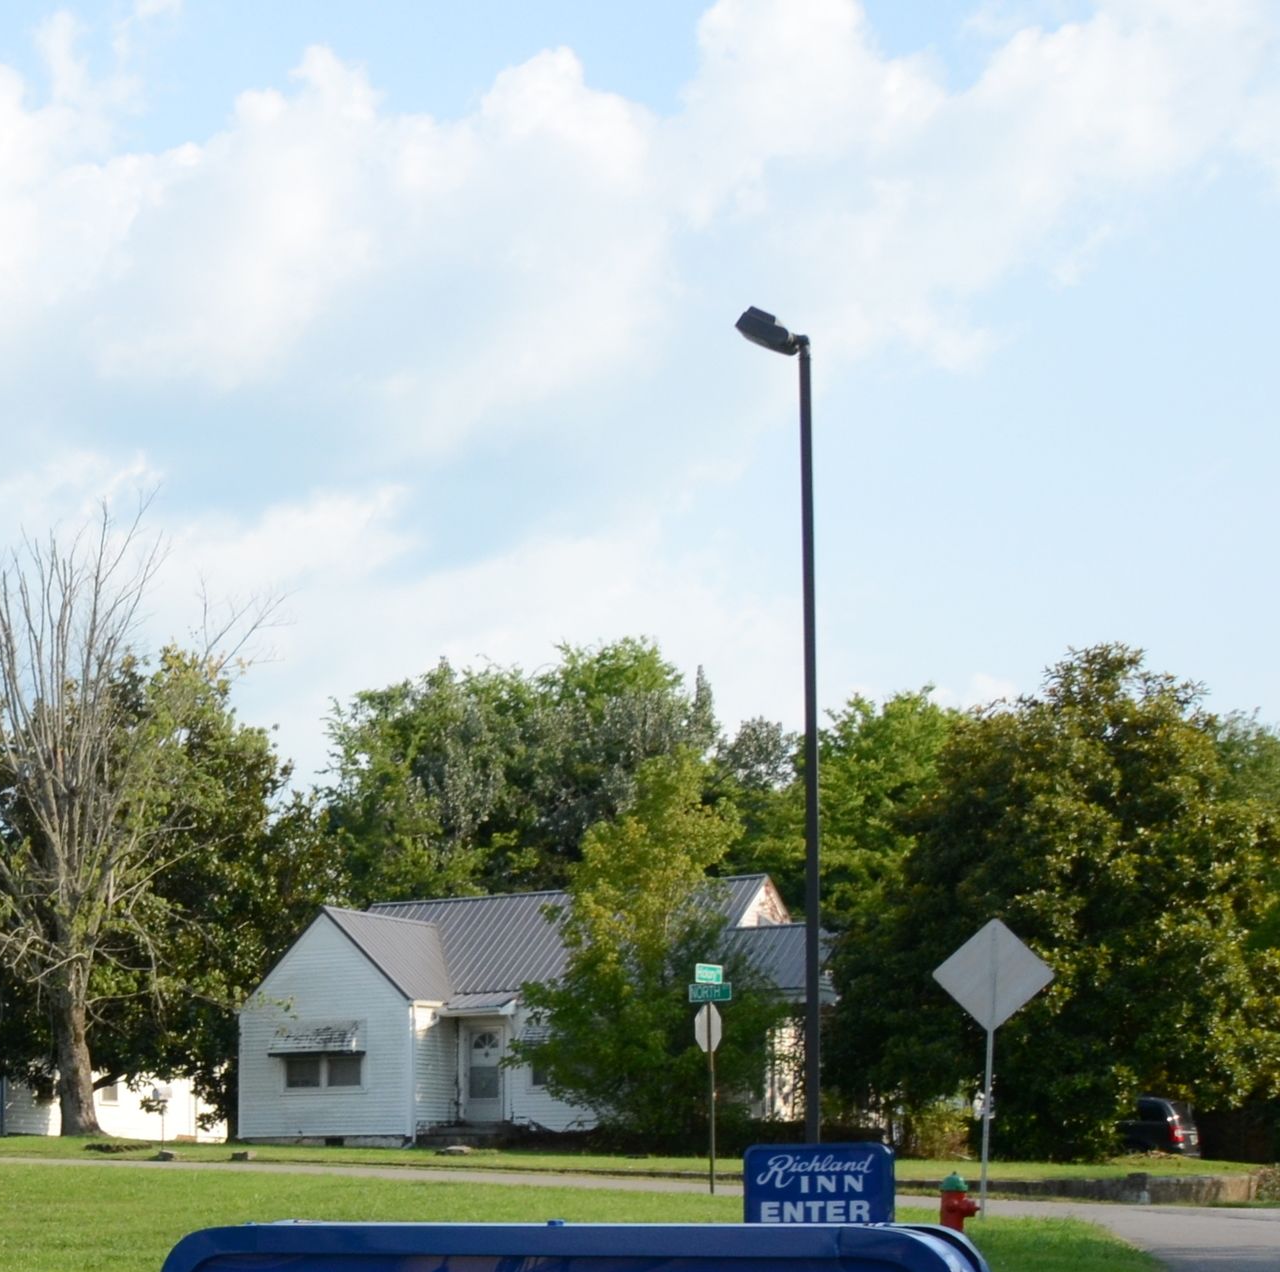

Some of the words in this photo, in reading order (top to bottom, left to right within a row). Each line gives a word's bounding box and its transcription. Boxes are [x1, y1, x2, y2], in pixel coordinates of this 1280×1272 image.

[692, 984, 721, 999] NORTH
[756, 1153, 874, 1188] Richland
[800, 1174, 864, 1194] INN
[760, 1200, 871, 1223] ENTER
